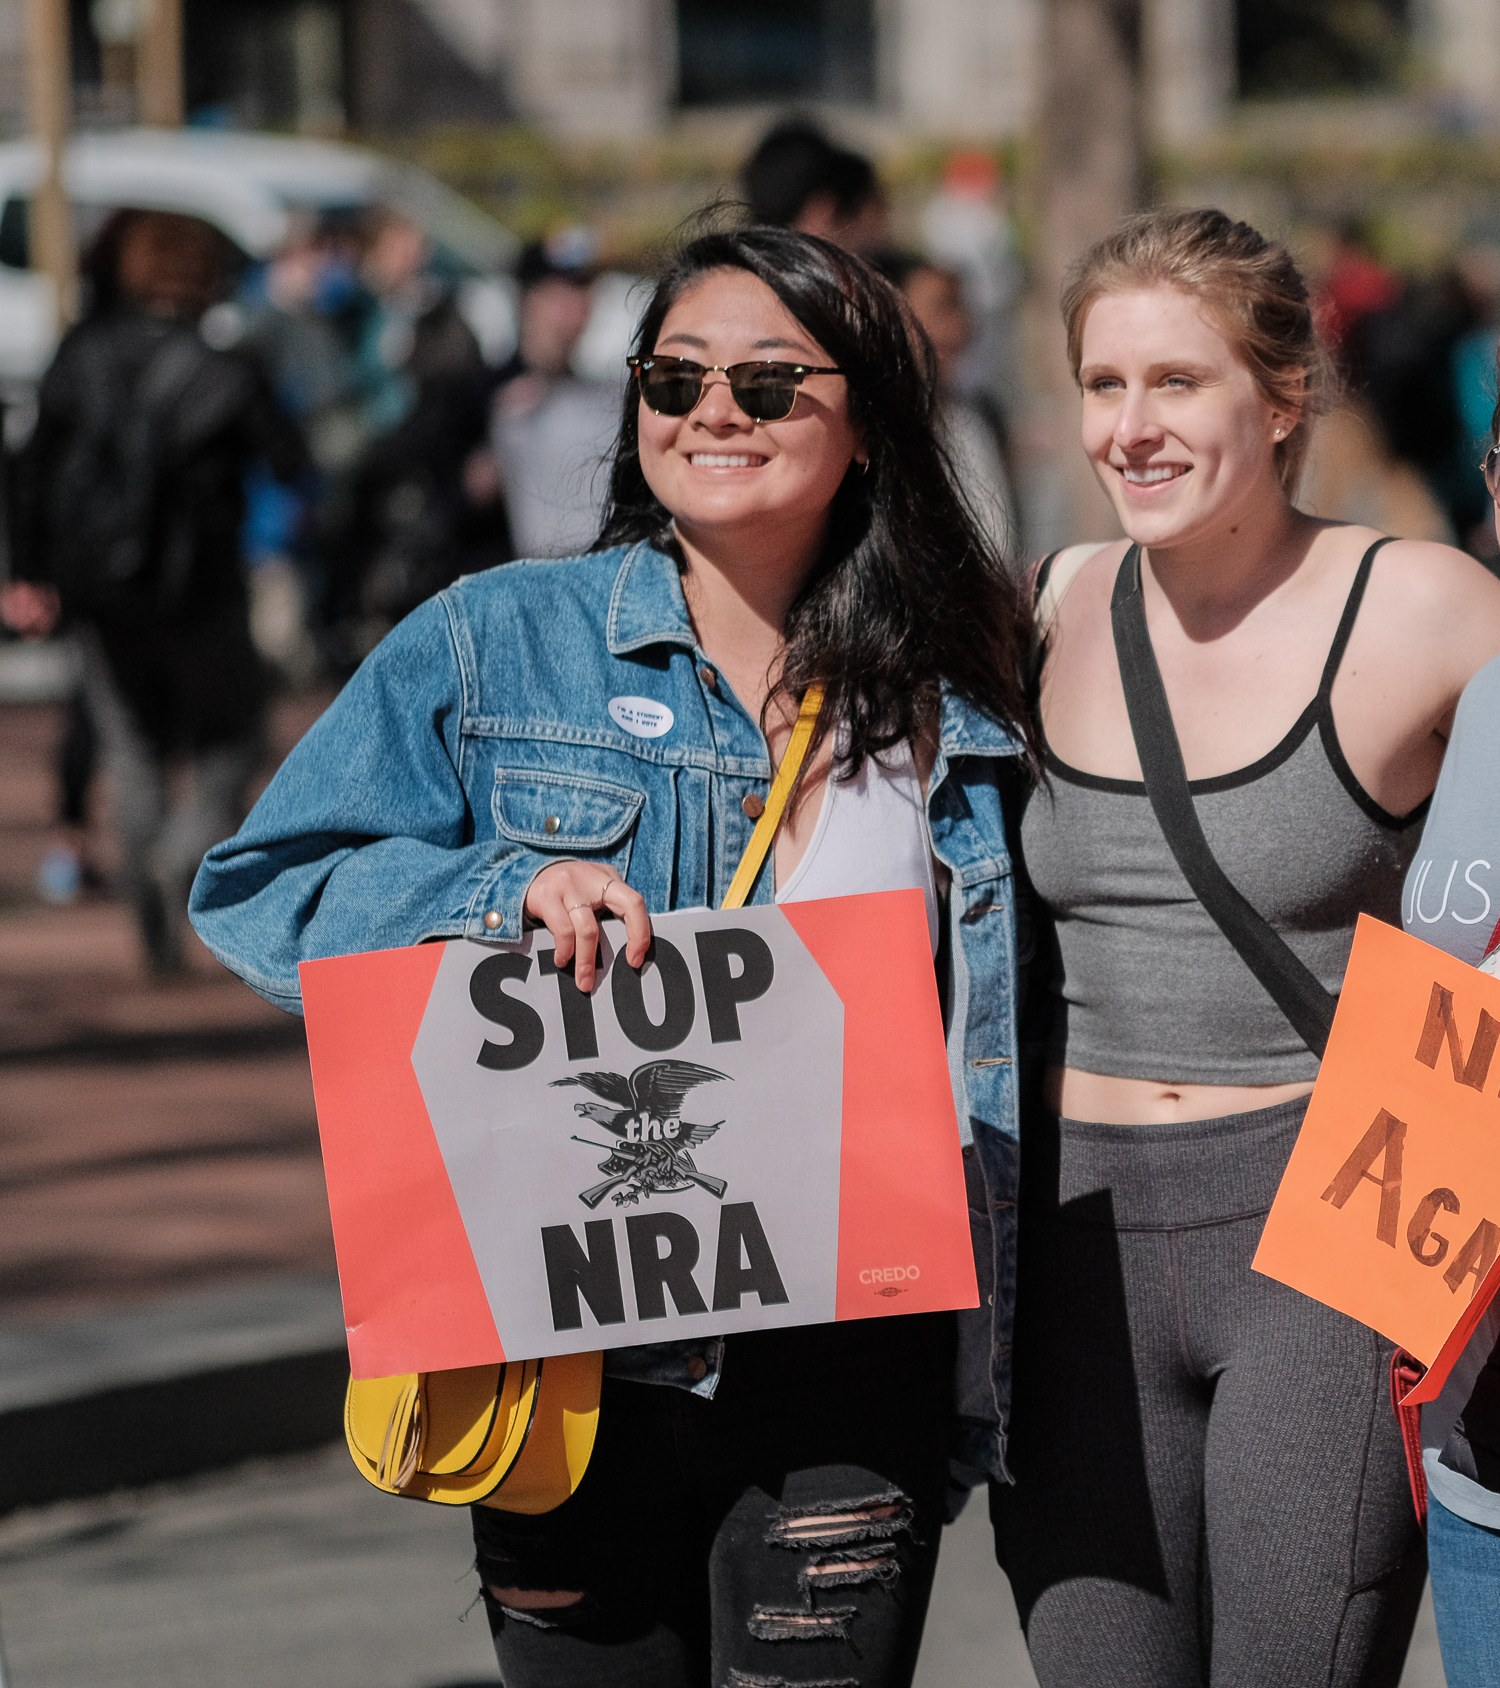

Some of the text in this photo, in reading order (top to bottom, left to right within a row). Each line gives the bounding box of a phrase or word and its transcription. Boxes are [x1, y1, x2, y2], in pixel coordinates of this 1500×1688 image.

[469, 927, 775, 1072] STOP
[624, 1112, 680, 1143] the
[540, 1201, 790, 1334] NRA
[859, 1265, 920, 1285] CREDO
